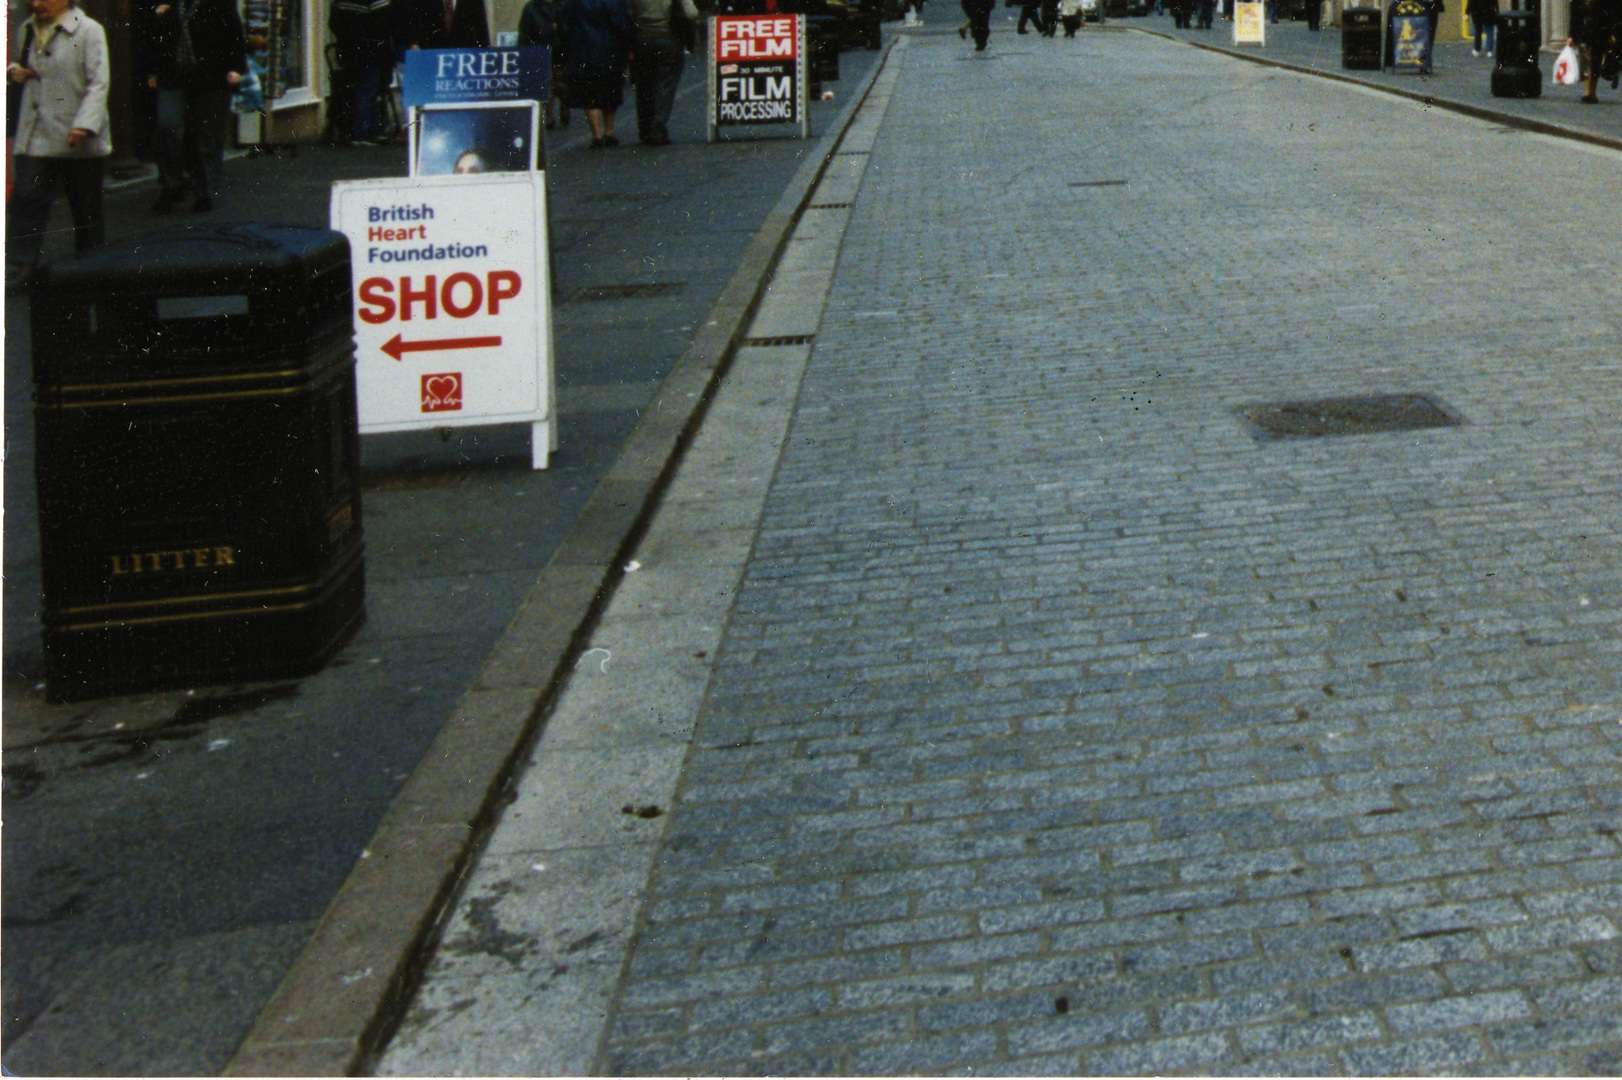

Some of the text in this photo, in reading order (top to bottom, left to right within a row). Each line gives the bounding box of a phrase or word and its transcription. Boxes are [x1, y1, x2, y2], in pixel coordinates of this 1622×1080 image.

[721, 19, 791, 39] FREE
[721, 38, 792, 57] FILM
[435, 51, 520, 78] FREE
[753, 65, 784, 73] MINUTE
[435, 77, 520, 92] REACTIONS
[721, 76, 791, 100] FILM
[720, 100, 792, 120] PROCESSING
[368, 204, 434, 222] British
[368, 224, 427, 242] Heart
[368, 243, 488, 263] Foundation
[357, 270, 522, 325] SHOP
[112, 545, 236, 576] LITTER
